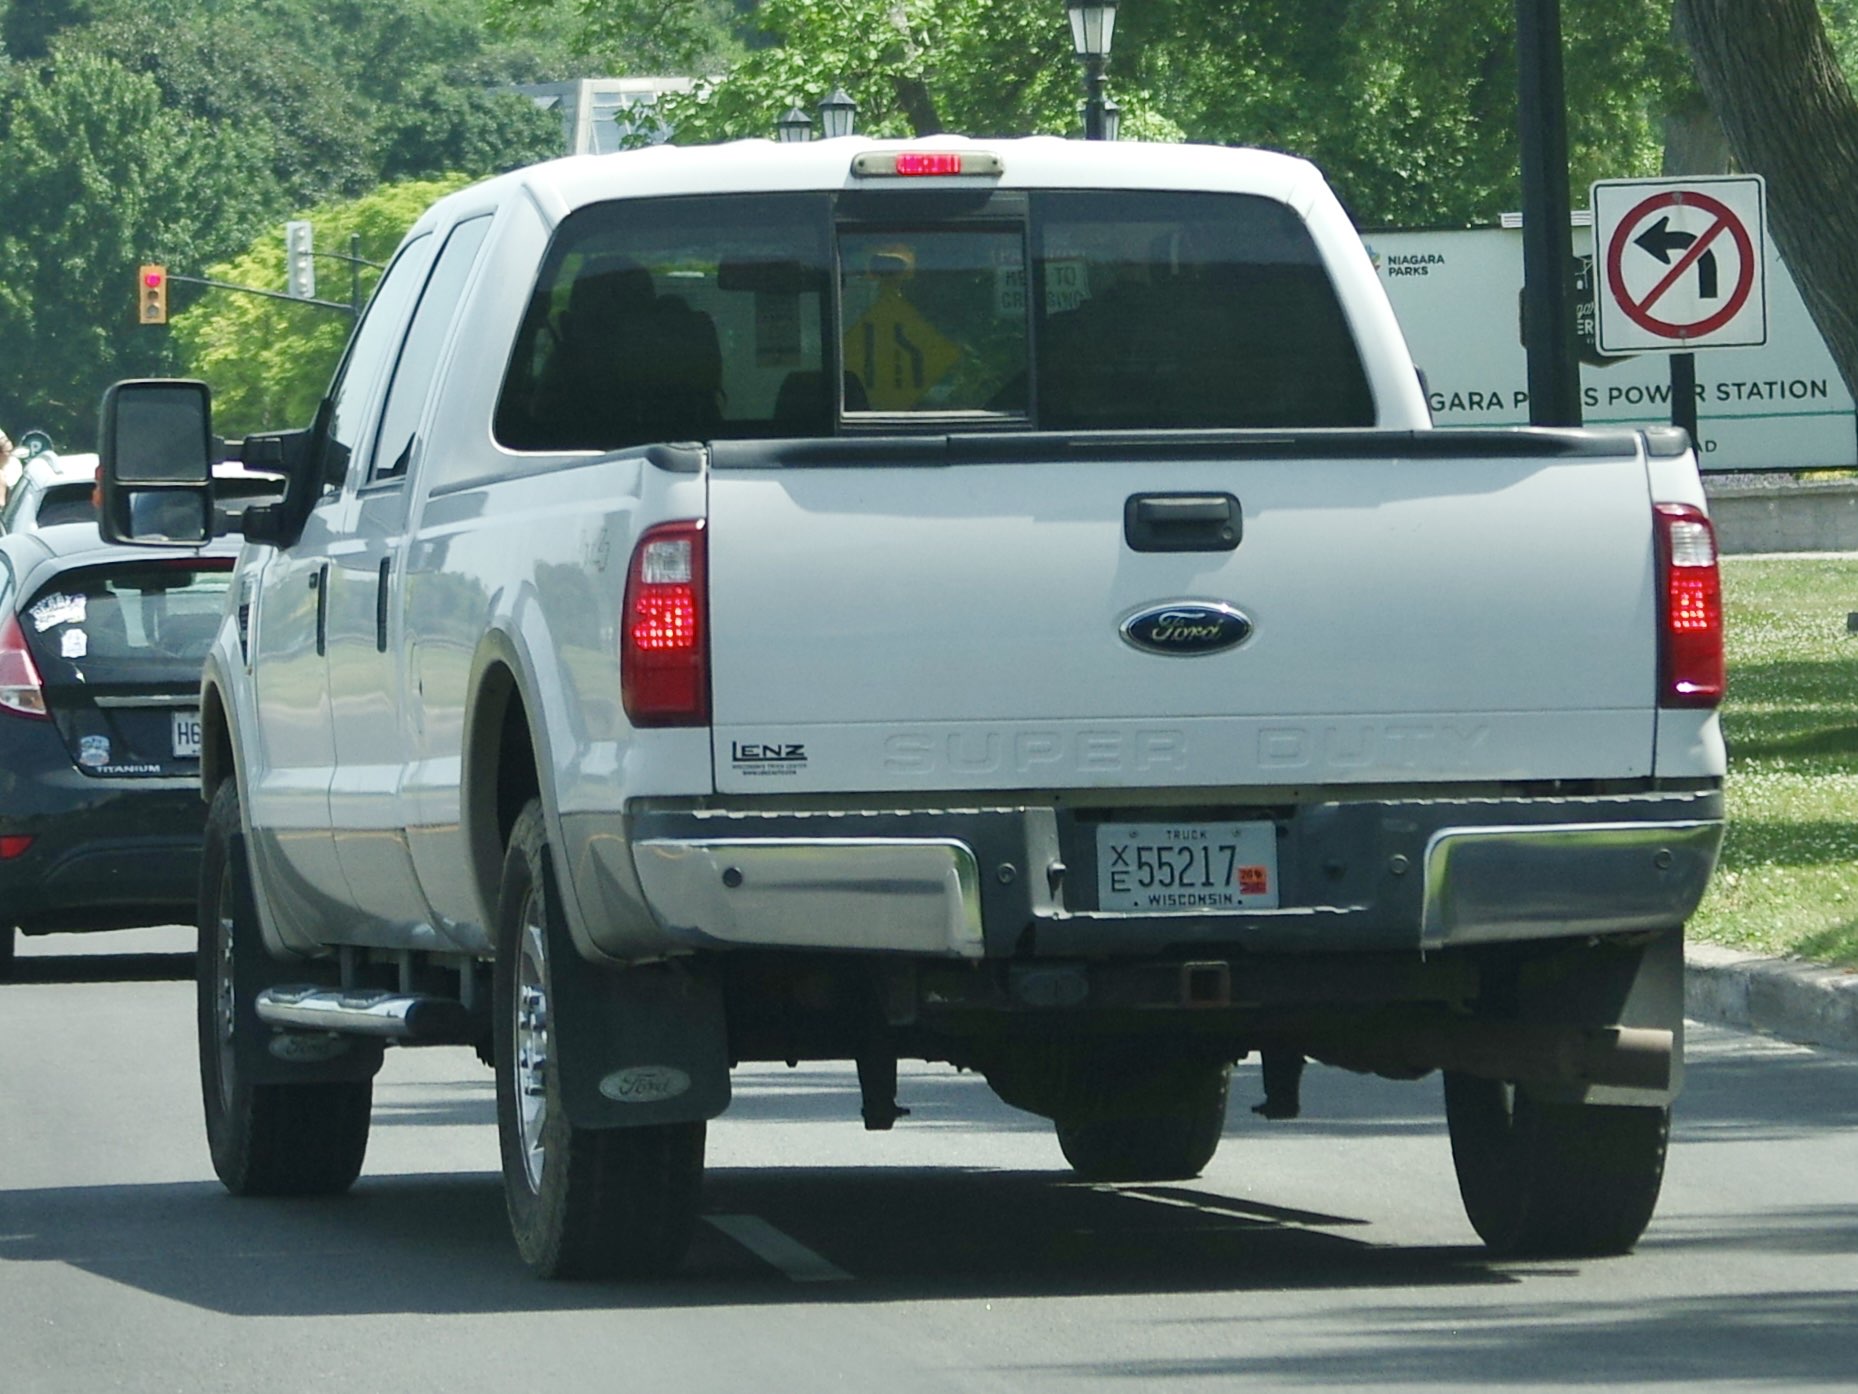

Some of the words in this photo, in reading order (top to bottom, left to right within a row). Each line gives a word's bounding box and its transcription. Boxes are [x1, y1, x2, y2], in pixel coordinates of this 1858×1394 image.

[1388, 254, 1445, 265] NIAGARA
[1053, 266, 1077, 286] TO
[1388, 266, 1429, 276] PARKS
[1430, 391, 1504, 411] GARA
[1608, 384, 1706, 406] POWR
[1716, 379, 1828, 401] STATION
[1151, 611, 1225, 641] Ford
[732, 741, 808, 762] LENZ
[882, 728, 1190, 776] SUPER
[1255, 721, 1493, 770] DUTY
[96, 764, 161, 773] TITANIUM
[1167, 830, 1208, 840] TRUCK
[1136, 844, 1238, 889] 55217
[1148, 893, 1234, 907] WISCONSIN
